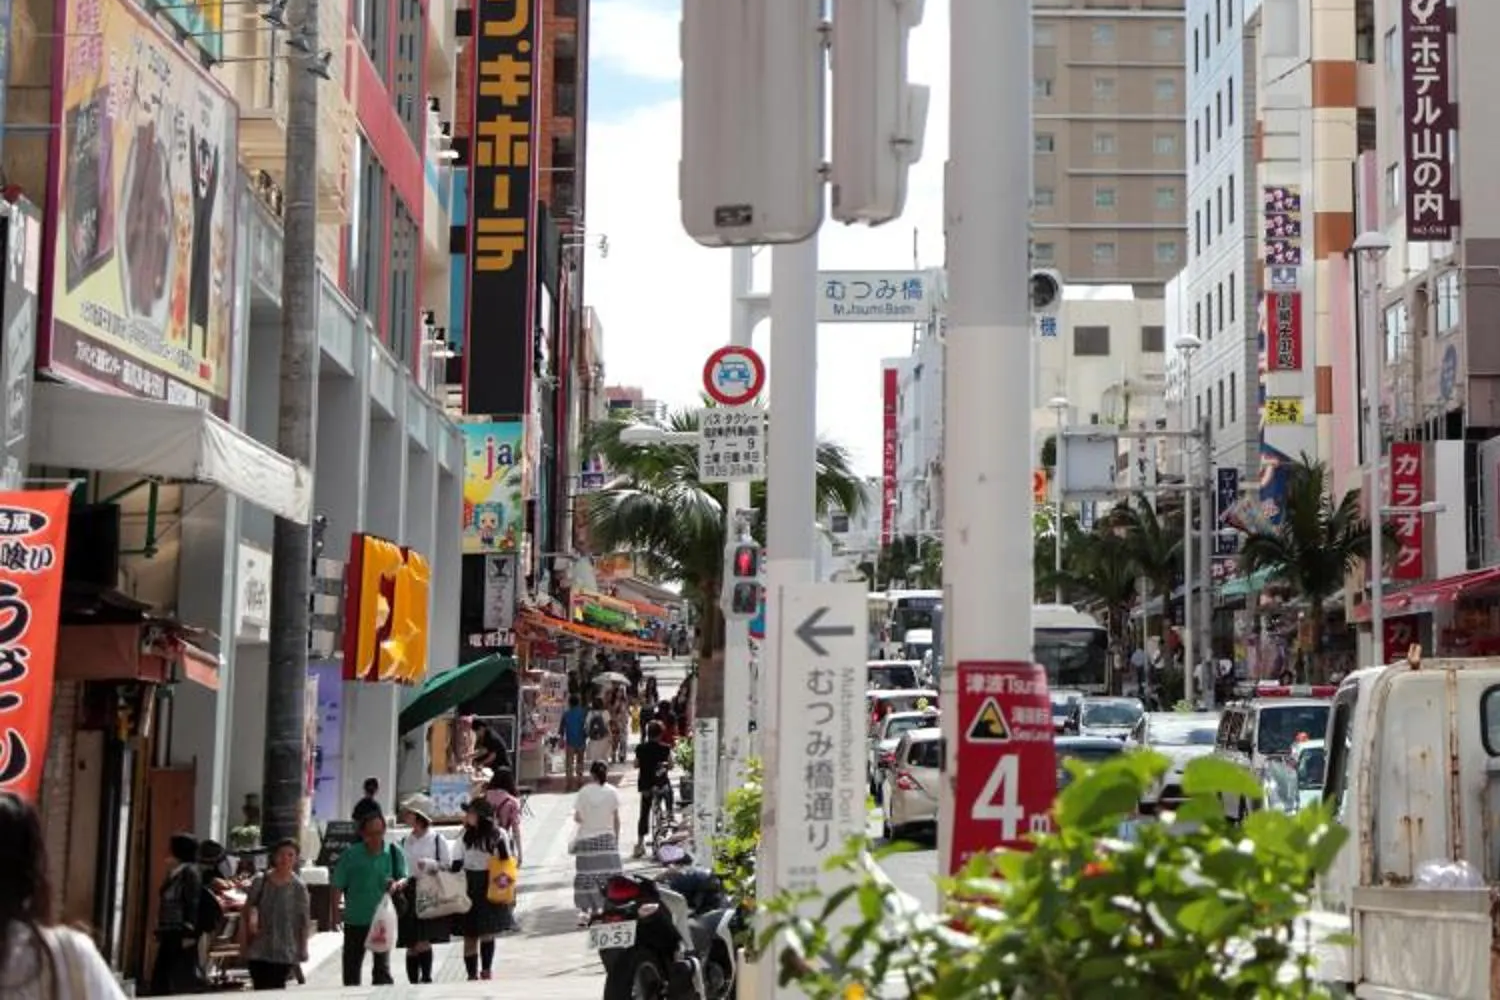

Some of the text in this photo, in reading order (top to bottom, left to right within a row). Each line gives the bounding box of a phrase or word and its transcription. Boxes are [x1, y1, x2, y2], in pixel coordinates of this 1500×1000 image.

[1411, 36, 1444, 222] ホテル山の内
[825, 279, 923, 300] むつみ橋
[1394, 453, 1421, 566] カラオケ
[804, 668, 836, 851] むつみ橋通り
[971, 754, 1025, 842] 4
